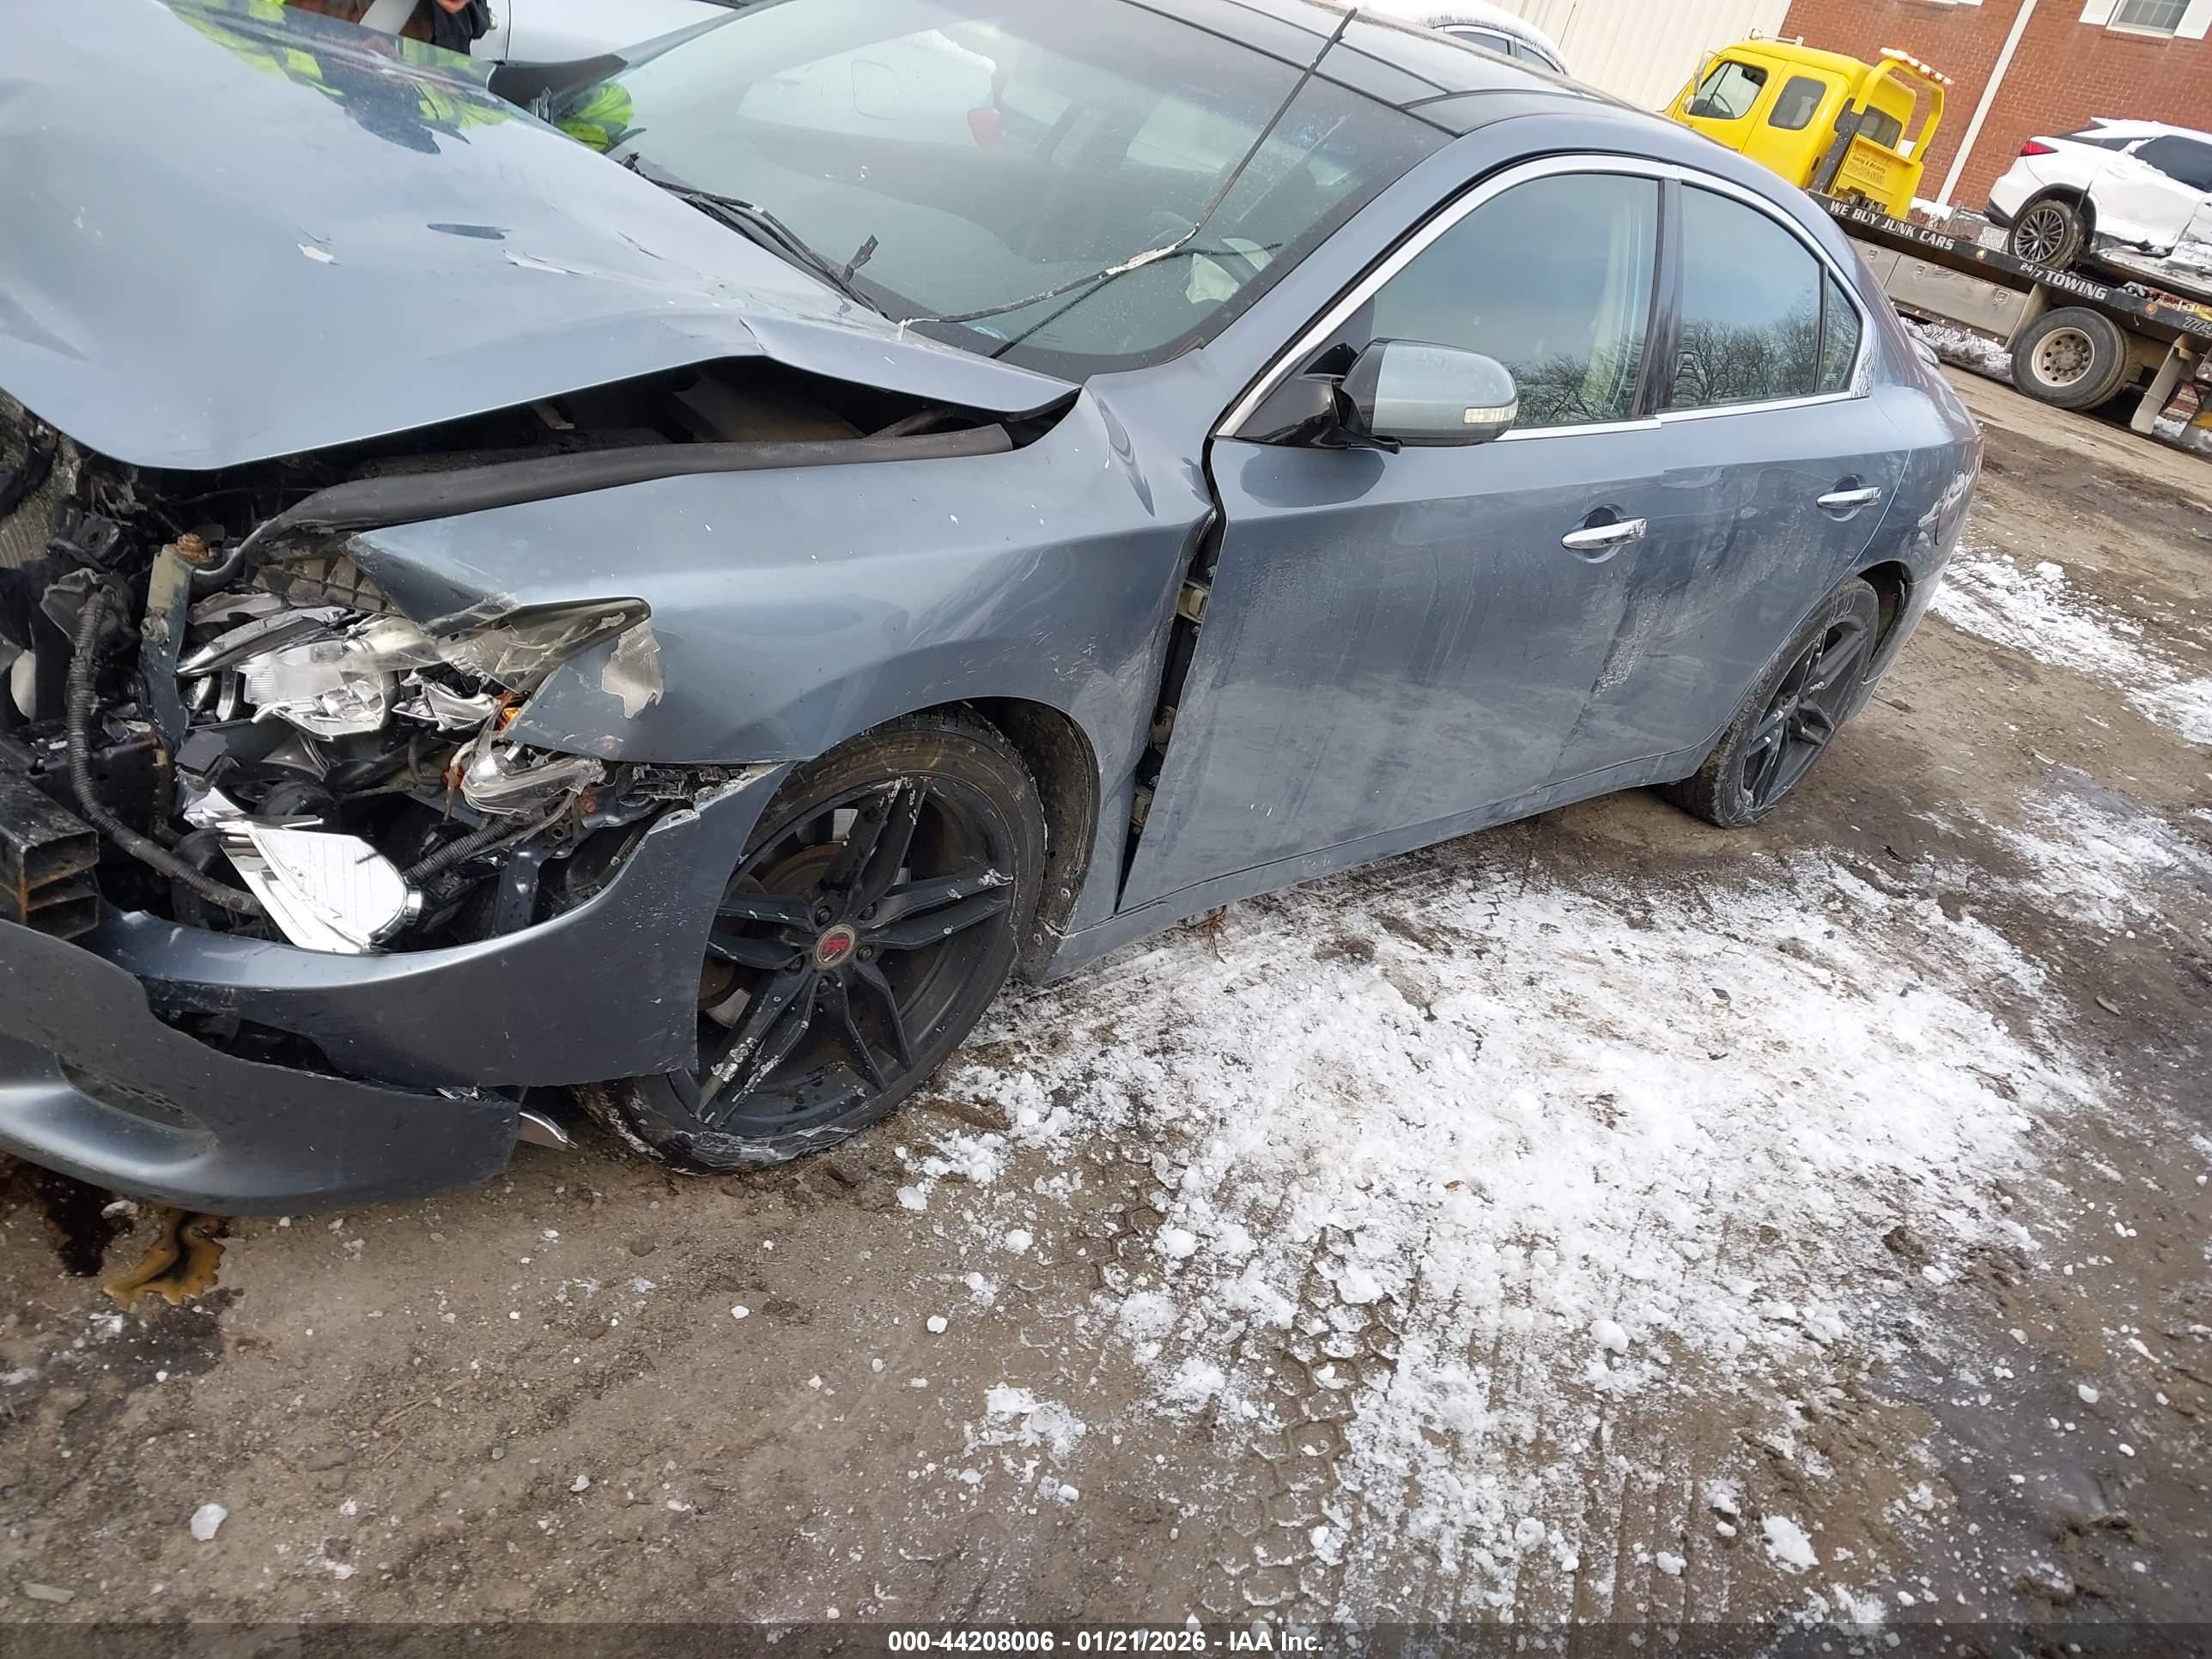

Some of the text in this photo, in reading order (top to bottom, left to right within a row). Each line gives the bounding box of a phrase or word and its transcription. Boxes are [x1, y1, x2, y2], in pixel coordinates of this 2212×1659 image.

[1829, 201, 1956, 251] WE BUY JUNK CARS
[2019, 262, 2109, 301] 24/7 TOWING
